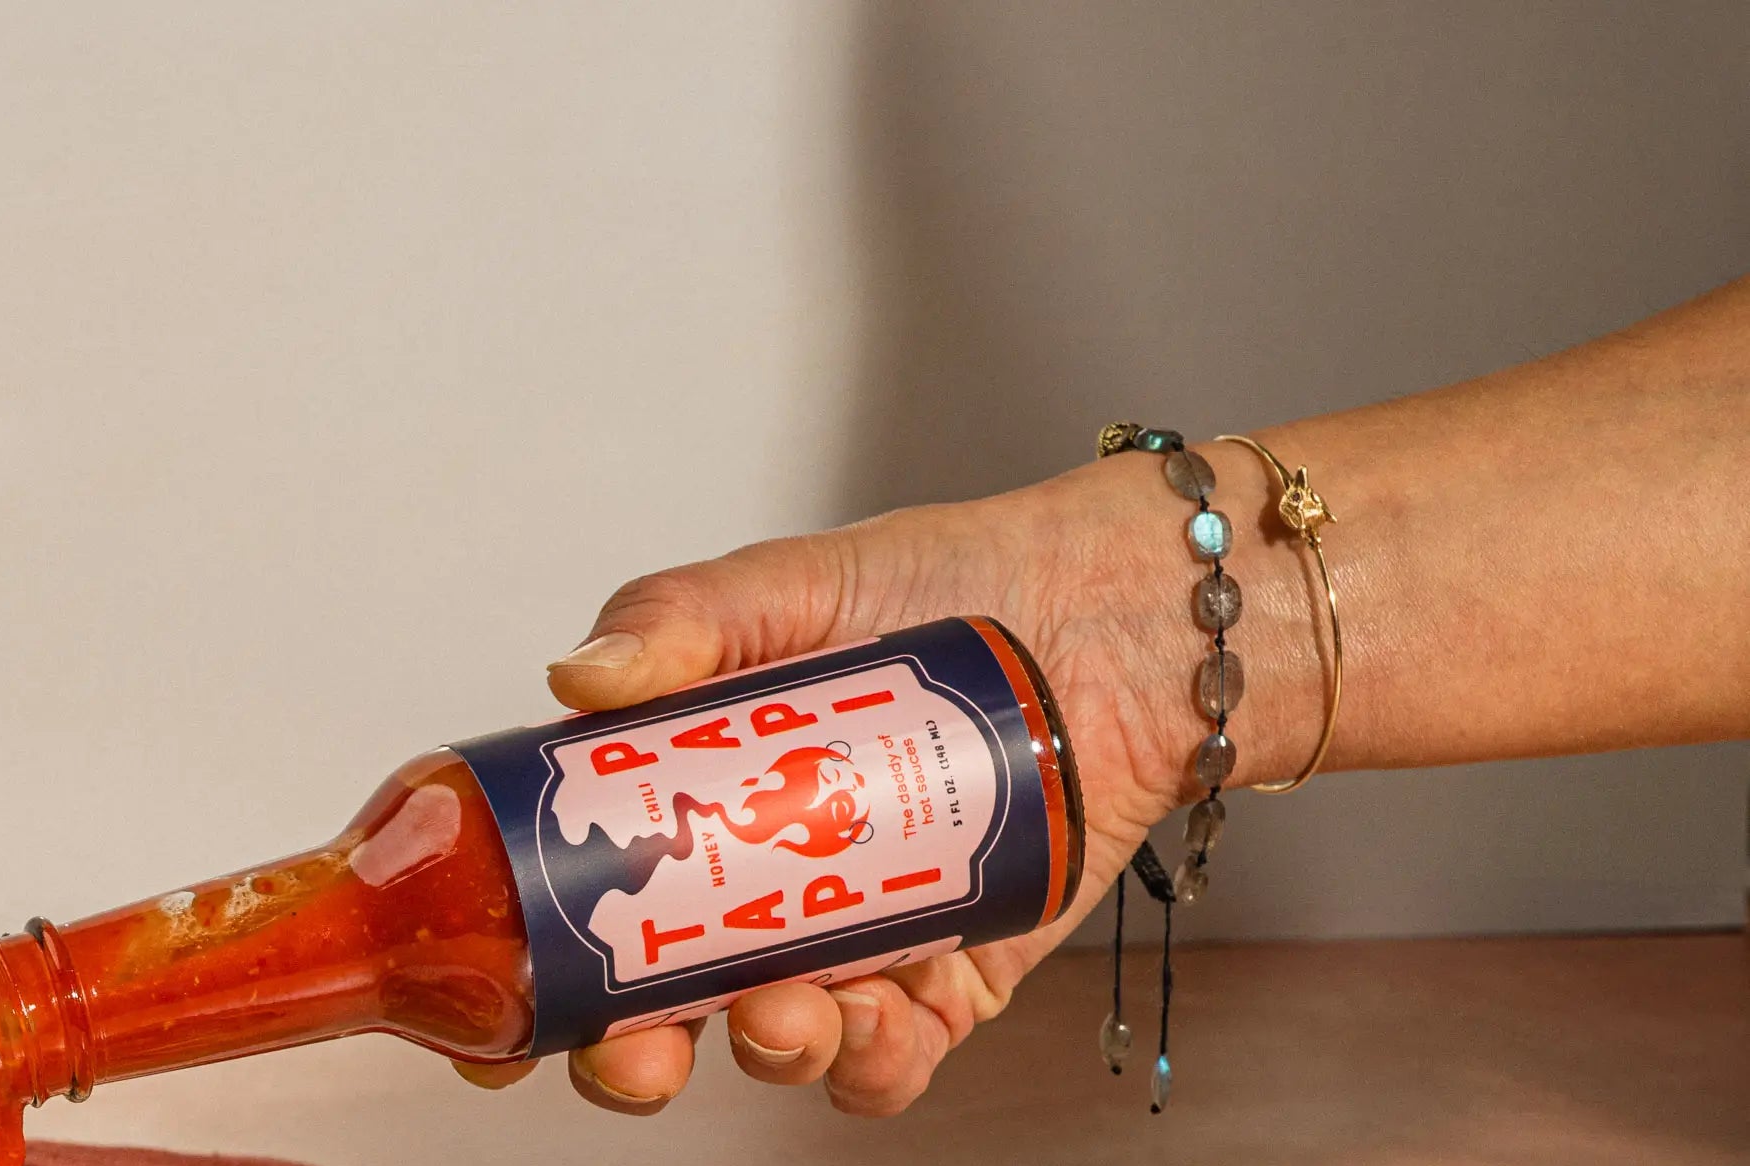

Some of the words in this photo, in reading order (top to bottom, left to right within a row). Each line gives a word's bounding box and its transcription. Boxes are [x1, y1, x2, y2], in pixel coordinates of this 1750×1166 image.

[877, 734, 894, 749] of
[925, 719, 941, 740] ML)
[903, 737, 928, 793] sauces
[934, 744, 950, 770] (148
[887, 752, 911, 804] daddy
[638, 782, 663, 823] CHILI
[919, 797, 935, 825] hot
[949, 799, 961, 814] FL
[903, 807, 917, 840] The
[953, 819, 963, 827] 5
[701, 832, 726, 887] HONEY
